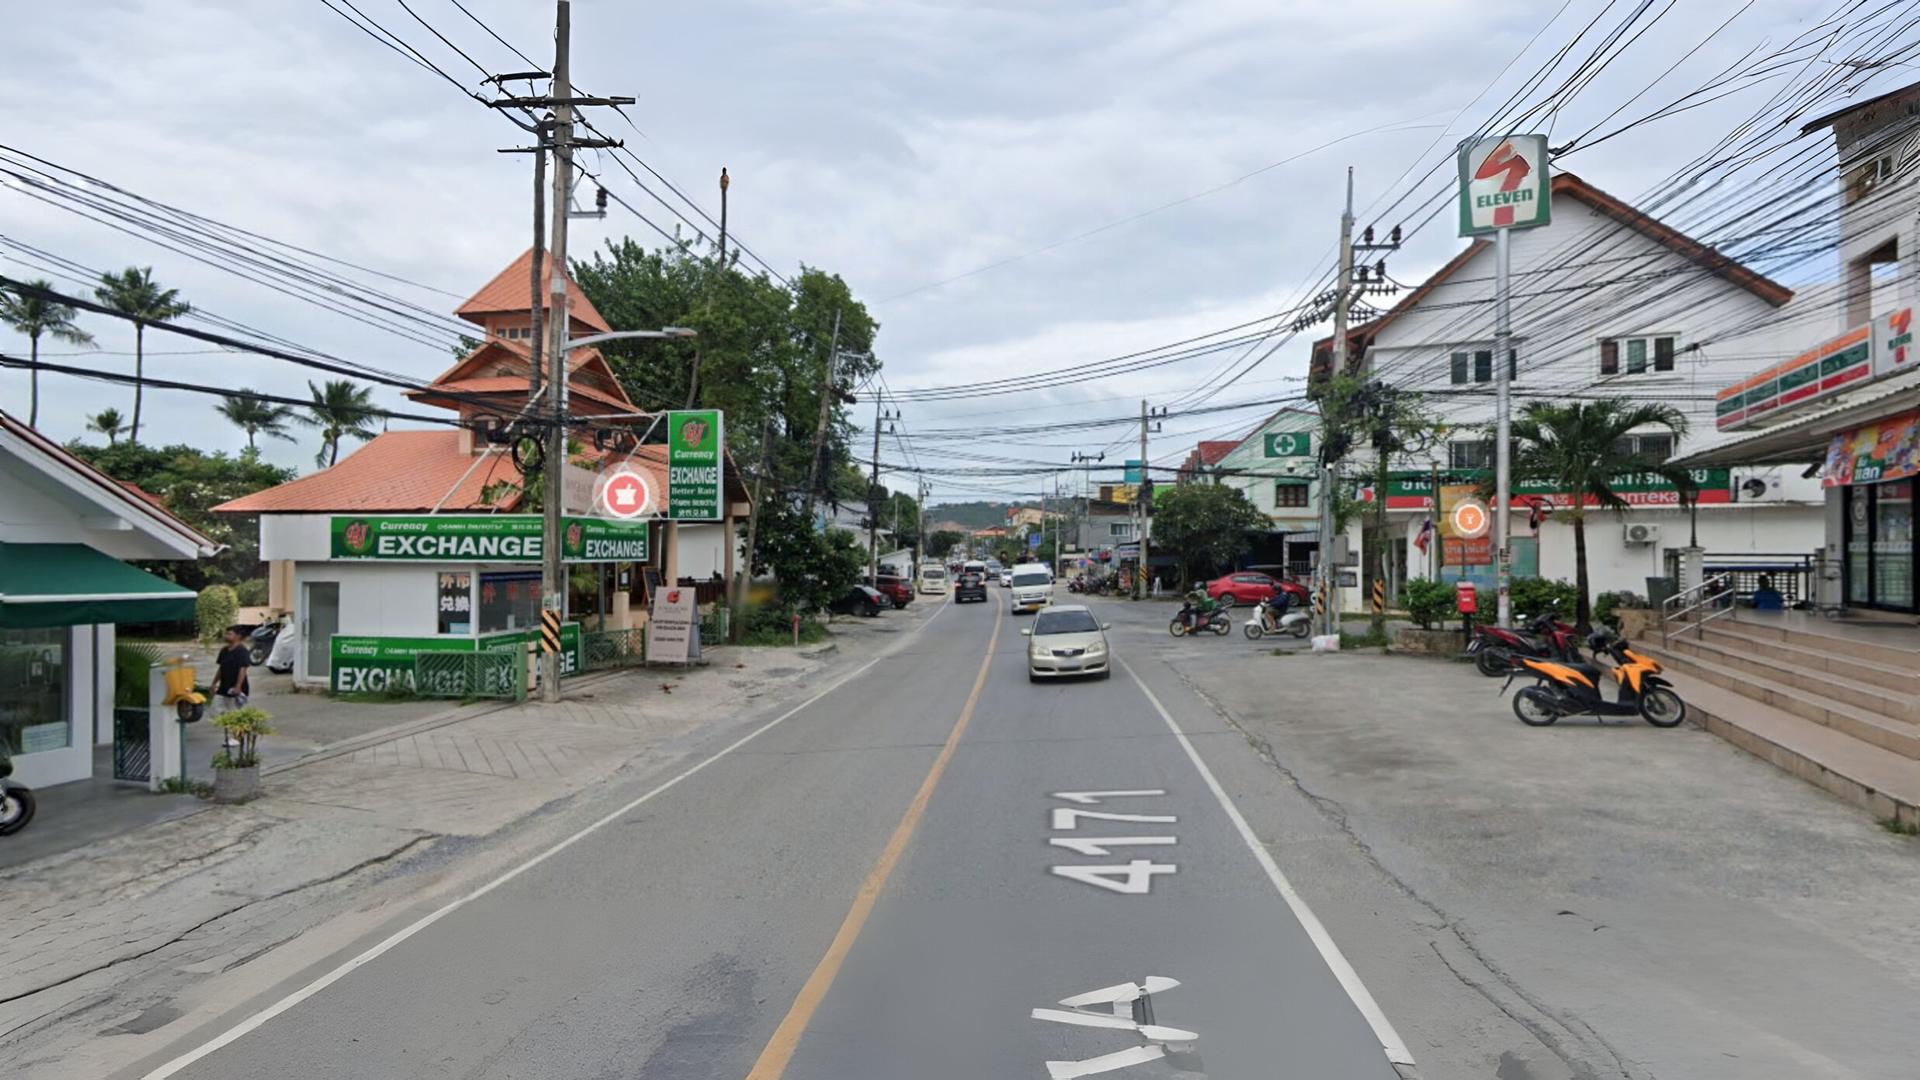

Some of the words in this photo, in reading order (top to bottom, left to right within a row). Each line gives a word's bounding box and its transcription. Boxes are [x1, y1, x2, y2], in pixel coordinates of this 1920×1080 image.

[674, 449, 715, 460] Currency
[671, 466, 717, 484] EXCHANGE
[380, 521, 429, 532] Currency
[377, 535, 543, 557] EXCHANGE
[585, 539, 645, 558] EXCHANGE
[341, 644, 379, 657] Currency
